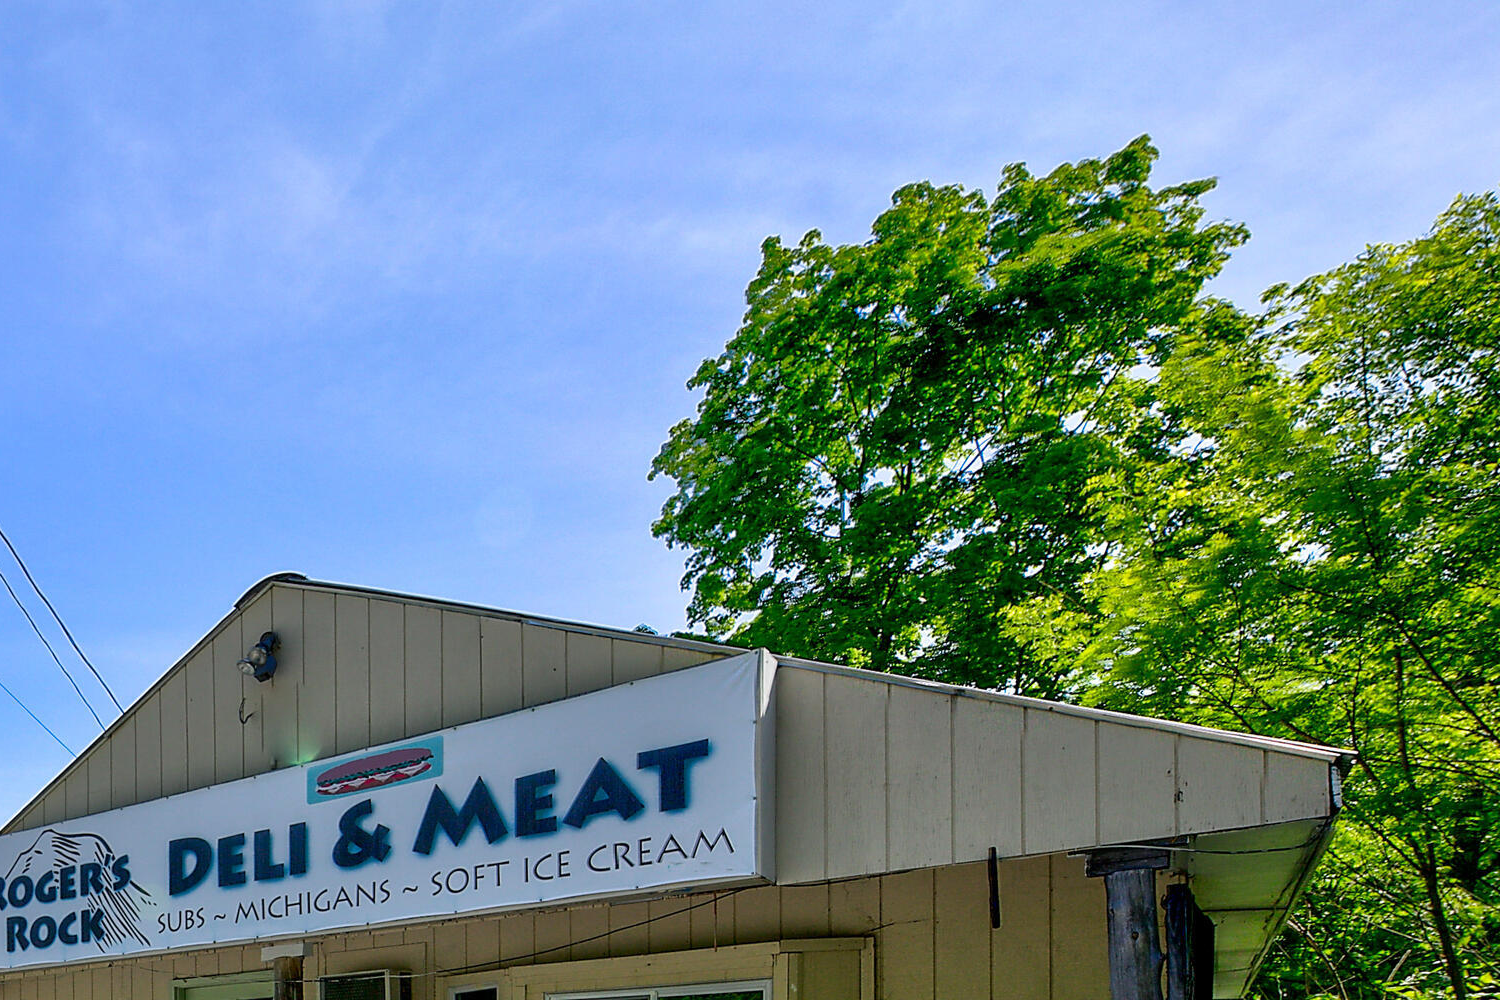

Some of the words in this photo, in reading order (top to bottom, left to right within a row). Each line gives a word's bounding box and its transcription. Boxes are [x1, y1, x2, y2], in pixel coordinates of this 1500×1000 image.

[169, 822, 307, 896] DELI
[333, 799, 392, 868] &
[412, 738, 709, 855] MEAT
[6, 907, 106, 952] ROCK
[157, 907, 205, 934] SUBS
[234, 879, 391, 924] MICHIGANS
[431, 860, 510, 896] SOFT
[524, 850, 571, 883] ICE
[587, 827, 735, 872] CREAM
